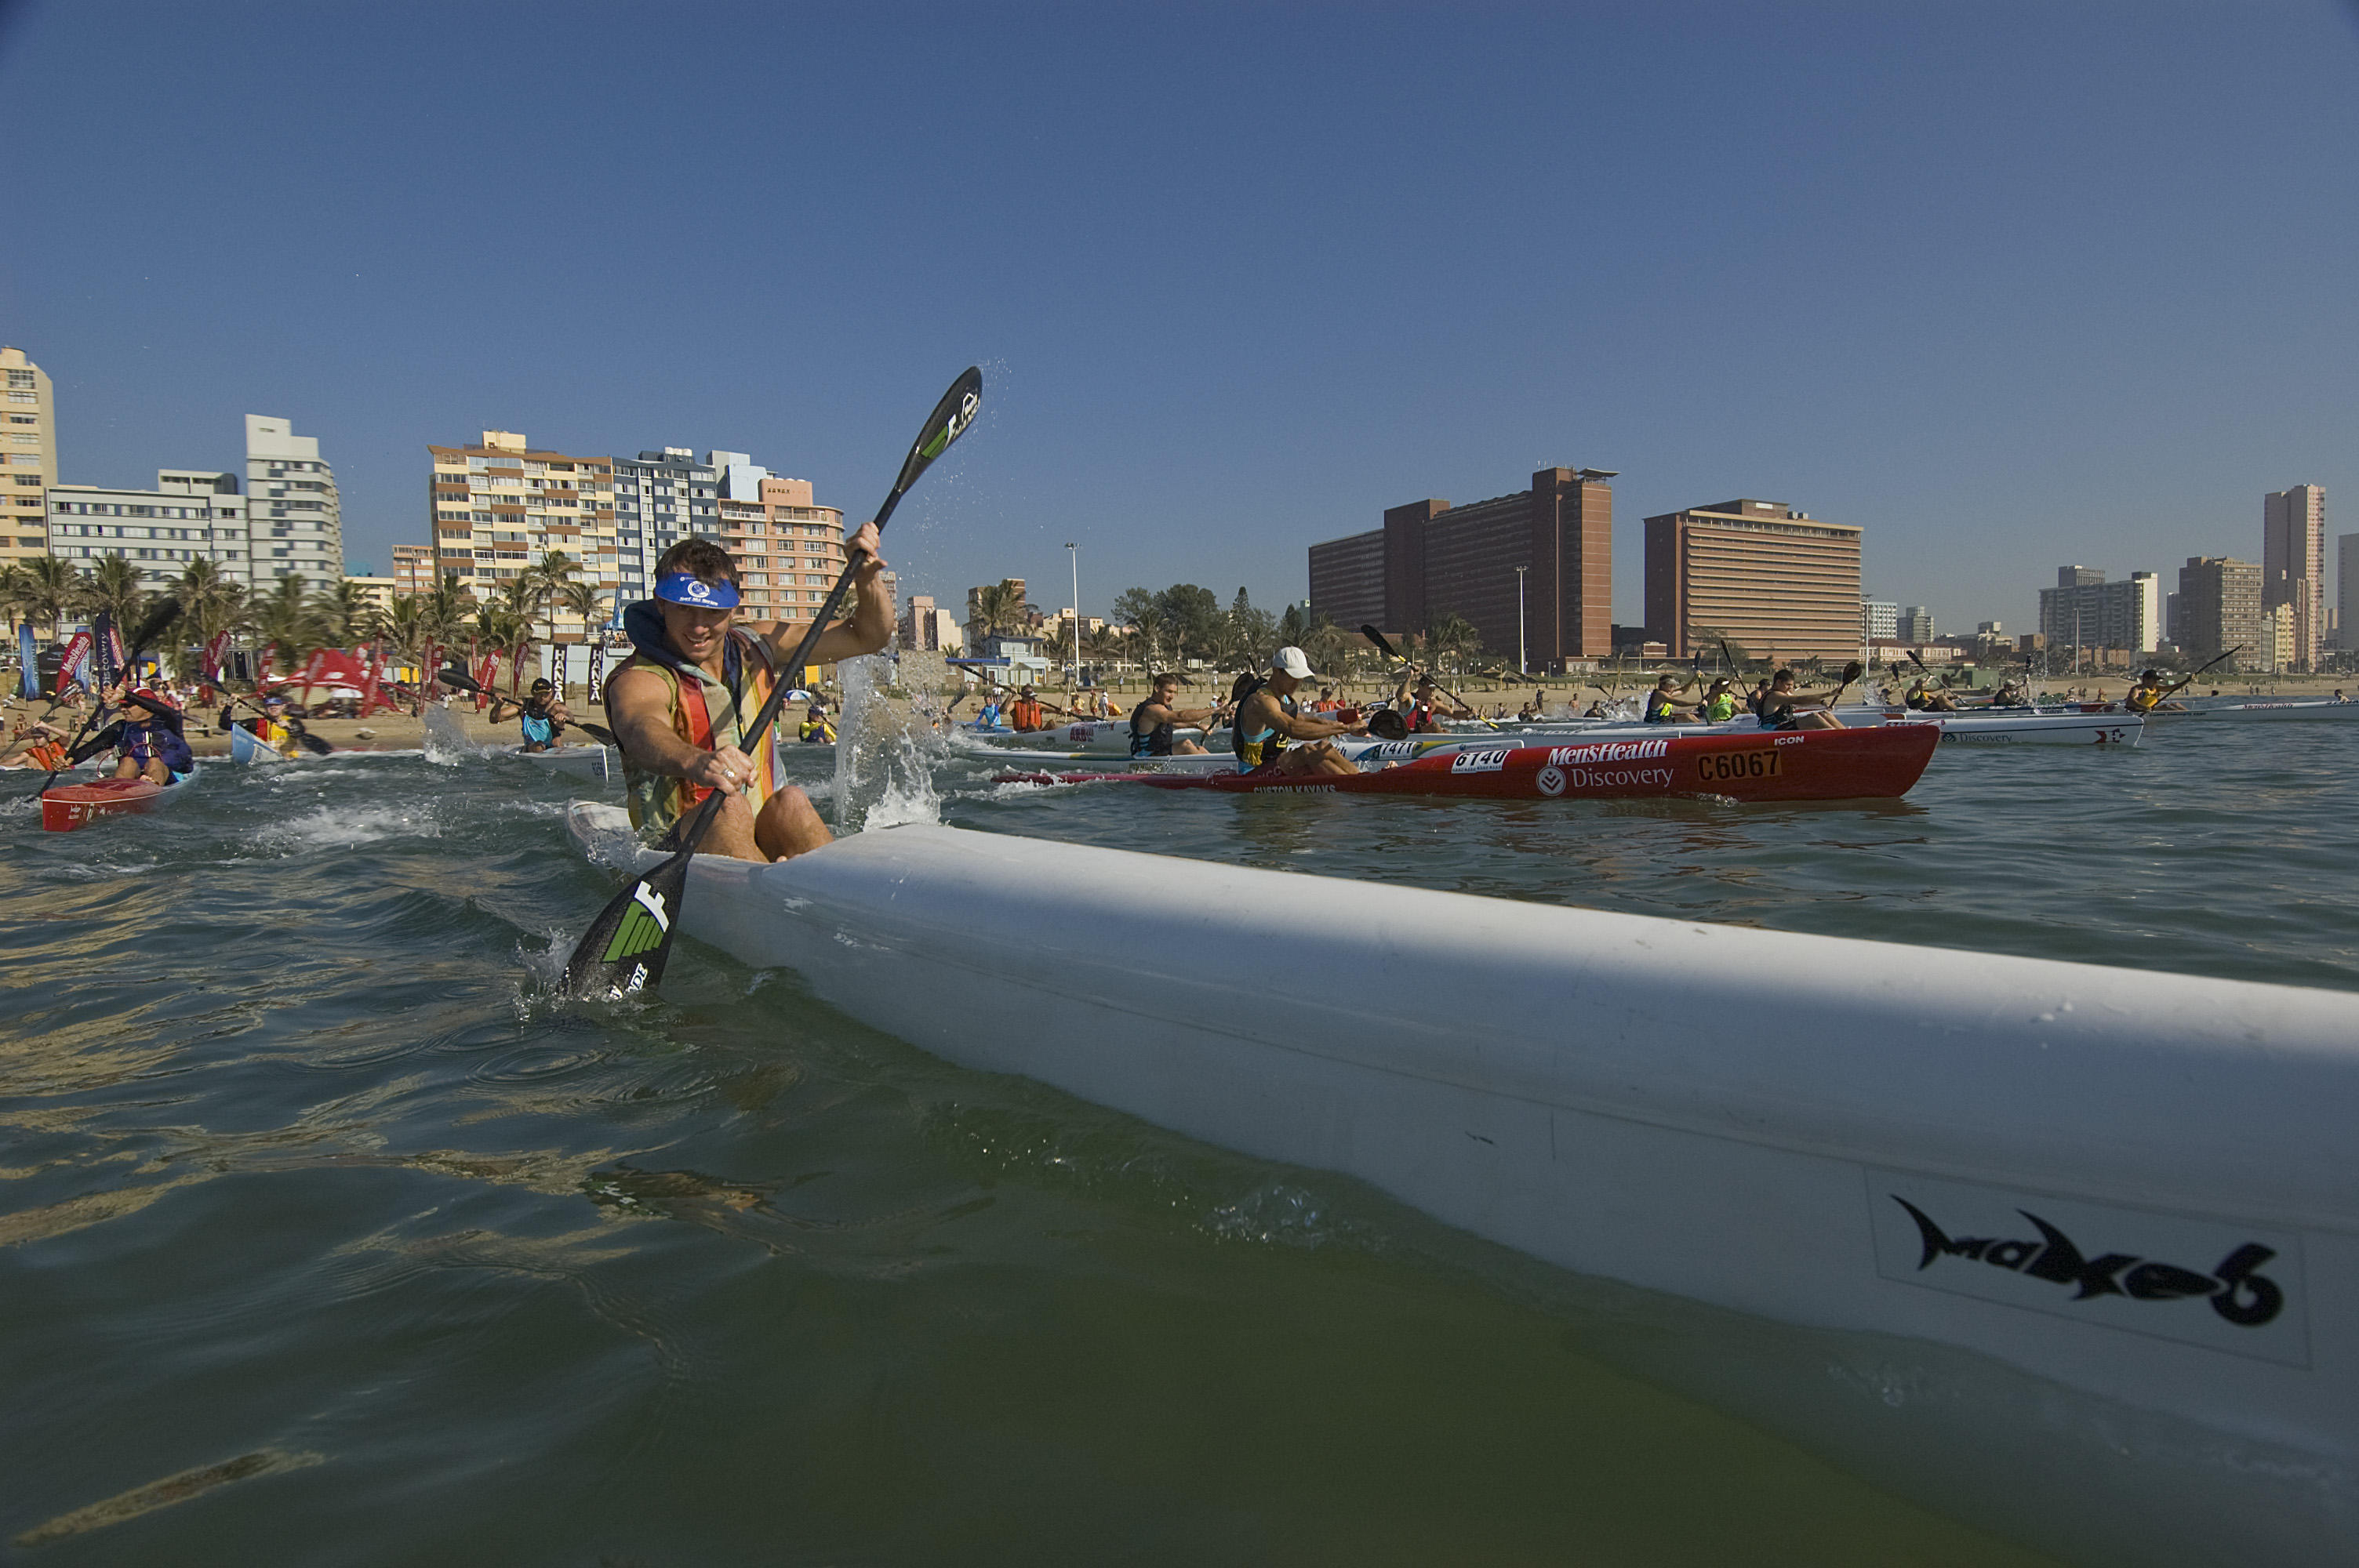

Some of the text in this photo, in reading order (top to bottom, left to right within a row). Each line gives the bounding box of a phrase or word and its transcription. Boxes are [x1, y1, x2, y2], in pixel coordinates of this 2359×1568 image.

[554, 649, 565, 702] HANSA
[591, 649, 602, 702] HANSA
[1774, 735, 1805, 746] ICON
[1961, 732, 2013, 742] Discovery
[1456, 750, 1508, 767] 6140
[1698, 750, 1779, 780] C6067
[1572, 768, 1674, 788] Discovery
